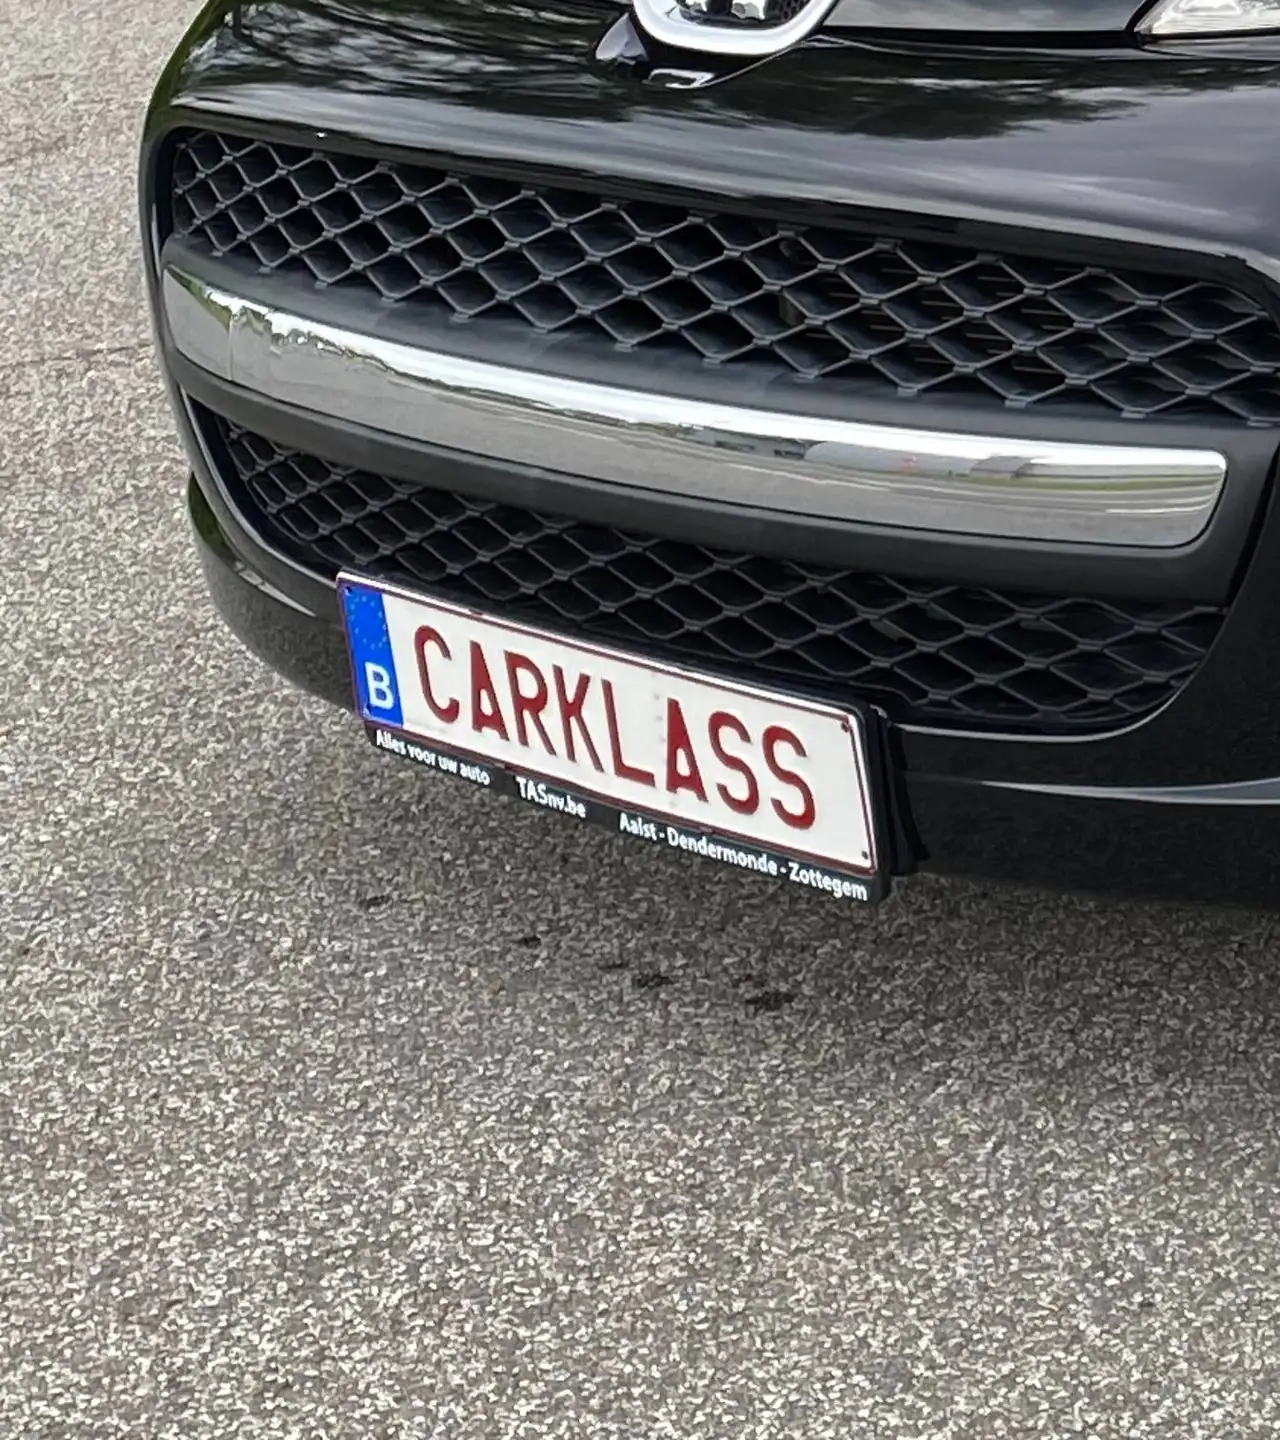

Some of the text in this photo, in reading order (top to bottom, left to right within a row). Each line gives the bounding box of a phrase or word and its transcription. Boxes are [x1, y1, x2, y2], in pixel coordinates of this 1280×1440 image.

[365, 664, 394, 710] B
[414, 625, 816, 830] CARKLASS
[376, 729, 491, 786] Alles voor uw auto
[516, 776, 586, 818] TASnv.be
[619, 812, 657, 841] Aalst
[667, 827, 778, 876] Dendermonde
[789, 862, 869, 901] Zottegem
